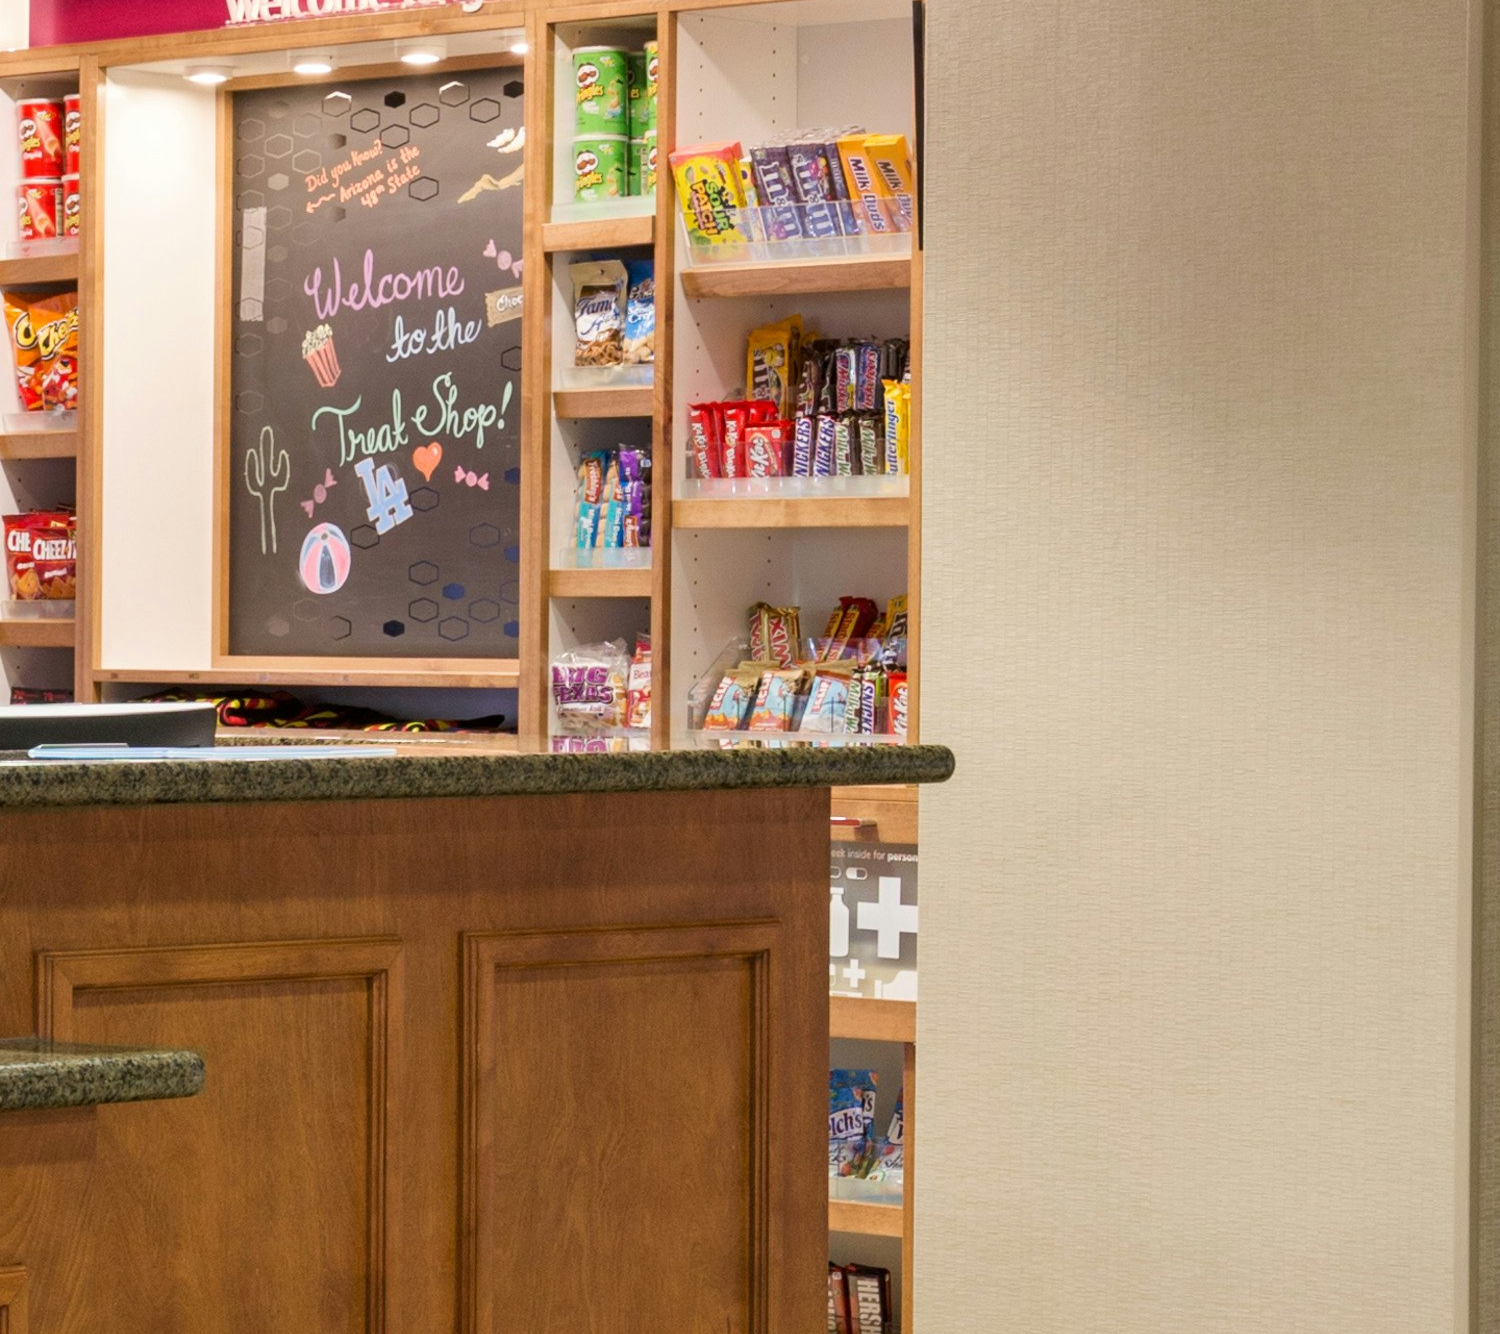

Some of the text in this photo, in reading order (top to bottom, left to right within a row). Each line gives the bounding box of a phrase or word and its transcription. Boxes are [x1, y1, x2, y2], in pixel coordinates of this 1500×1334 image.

[305, 139, 383, 192] Did you Know?
[340, 146, 420, 203] Arizona is the
[387, 165, 420, 194] State
[304, 248, 465, 320] Welcome
[386, 306, 483, 363] to the
[312, 371, 514, 467] Treat Shop!
[794, 418, 812, 477] NICKERS
[814, 417, 836, 477] NICKERS
[887, 400, 900, 475] utterfinger
[354, 457, 414, 535] LA
[862, 684, 874, 735] SNICKE
[847, 848, 872, 860] inside
[873, 849, 886, 860] for
